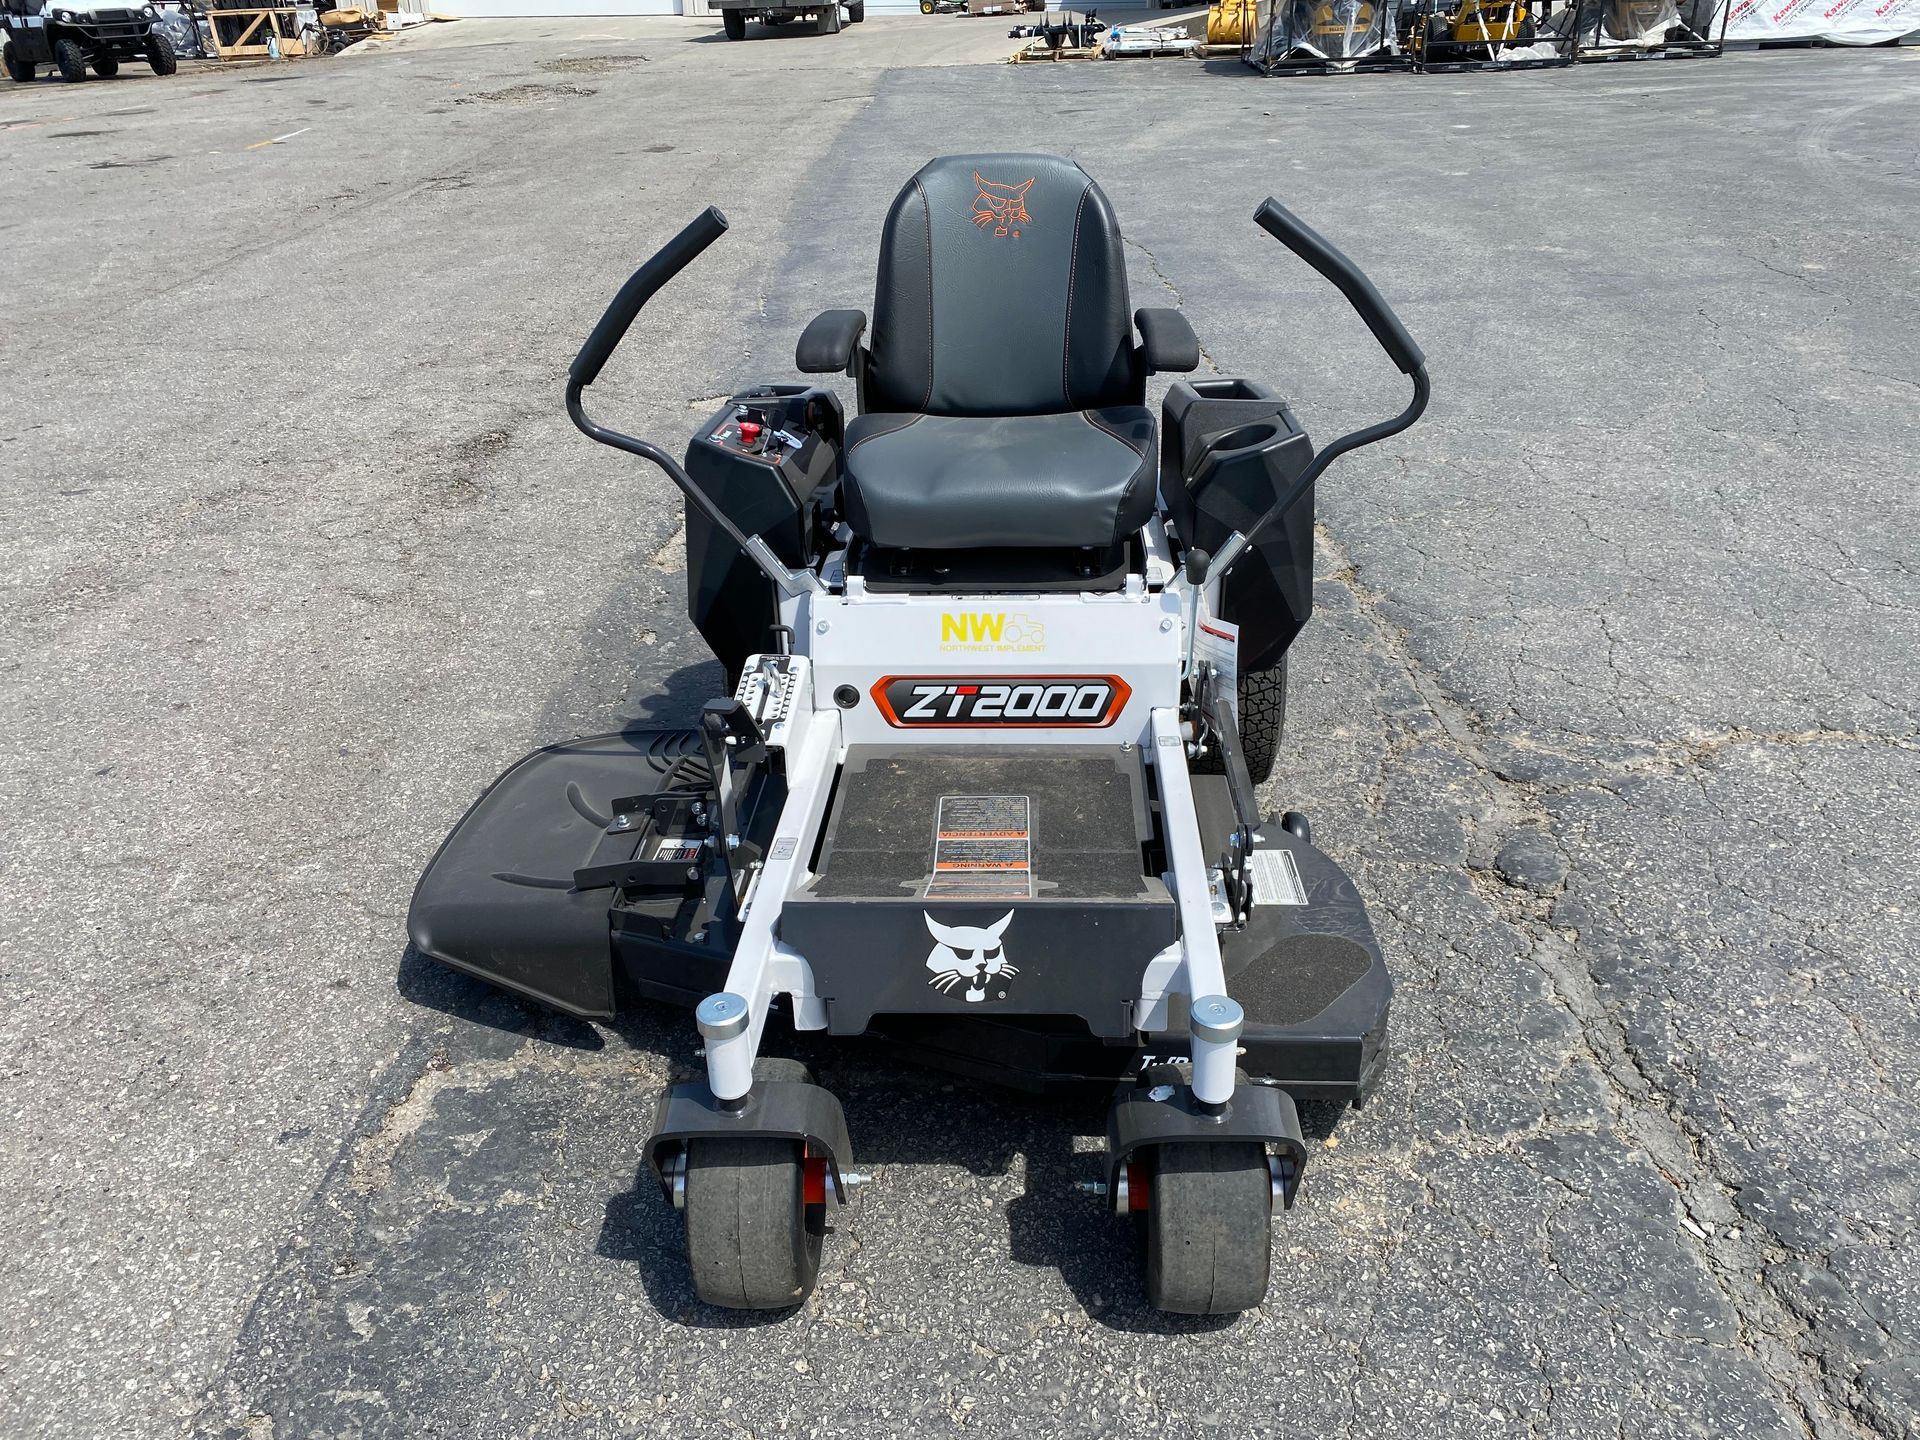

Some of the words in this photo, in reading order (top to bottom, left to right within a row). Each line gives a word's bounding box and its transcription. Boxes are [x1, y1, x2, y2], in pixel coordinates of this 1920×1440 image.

[941, 613, 1006, 642] NW
[939, 644, 995, 653] NORTHWEST
[997, 644, 1047, 653] IMPLEMENT
[903, 685, 1111, 718] ZT2000
